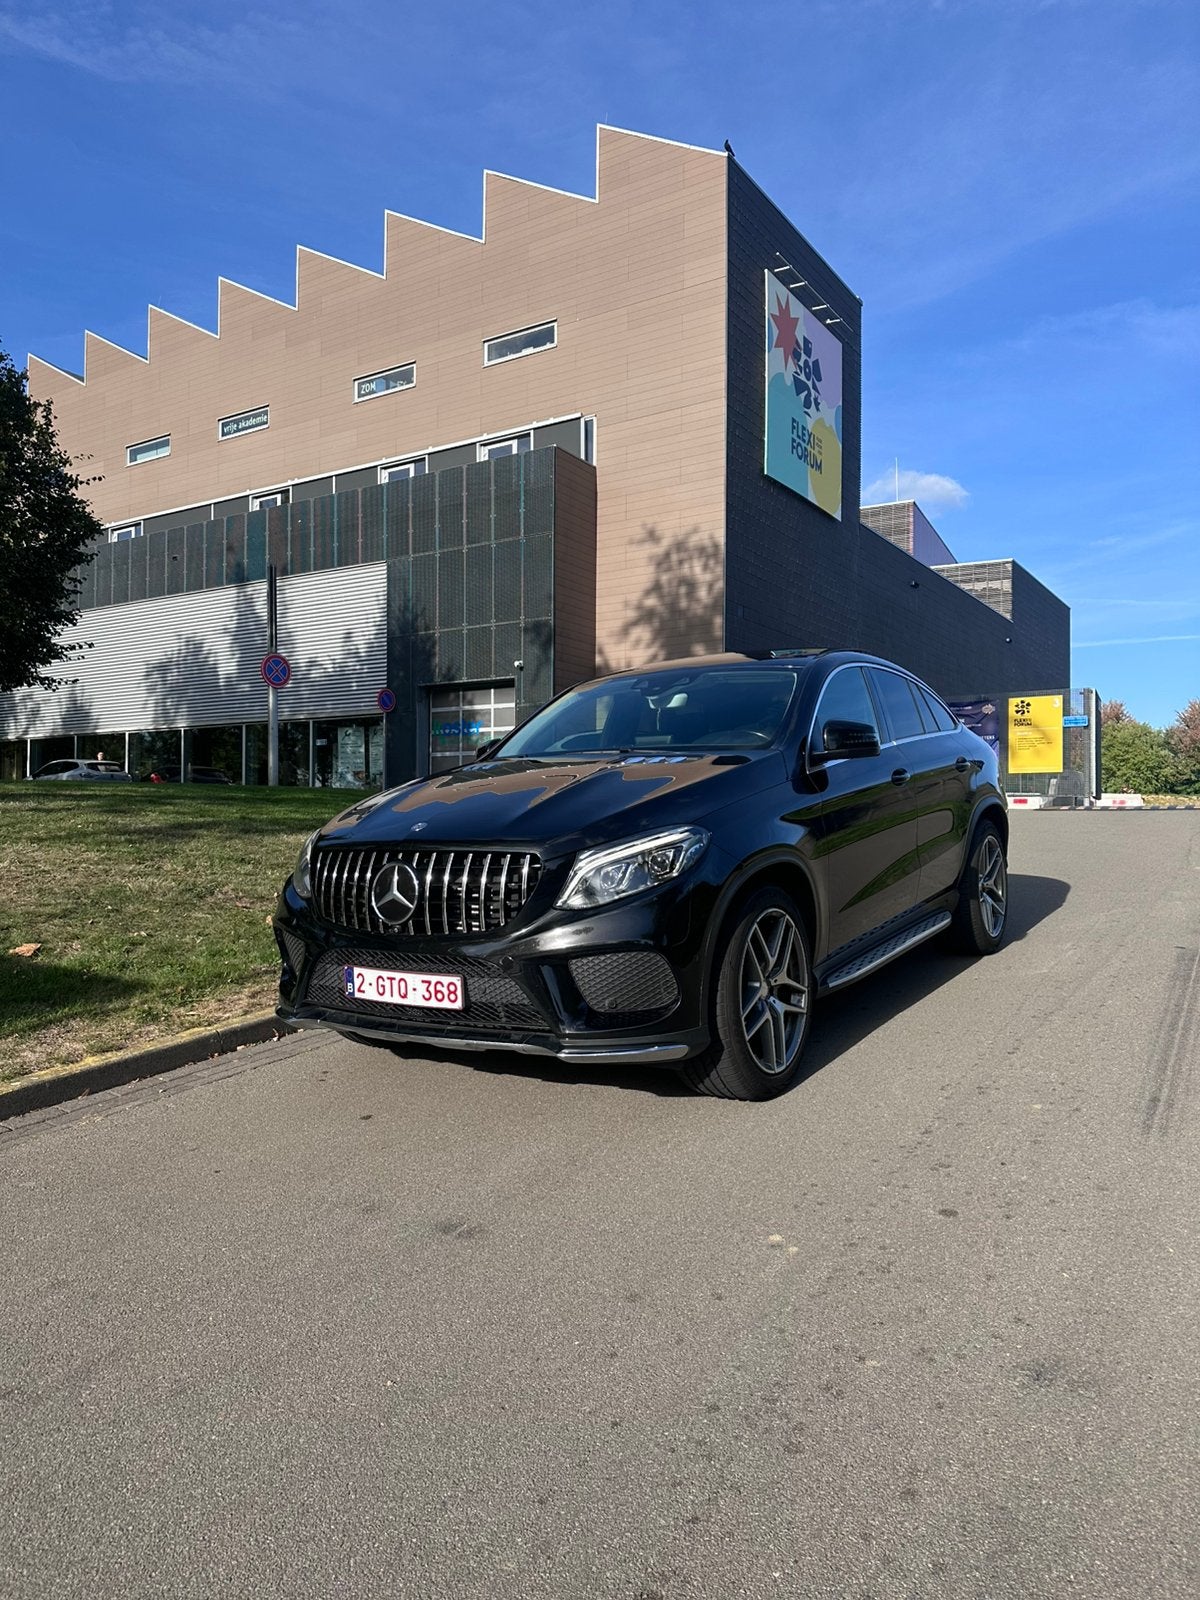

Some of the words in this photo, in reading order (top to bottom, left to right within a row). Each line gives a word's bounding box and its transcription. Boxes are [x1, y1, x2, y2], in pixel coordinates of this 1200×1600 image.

[223, 422, 237, 434] vrije
[238, 413, 268, 429] akademie
[791, 416, 816, 451] FLEXI
[791, 437, 823, 475] FORUM
[347, 982, 354, 993] B
[356, 972, 459, 1004] 2-GTQ-368
